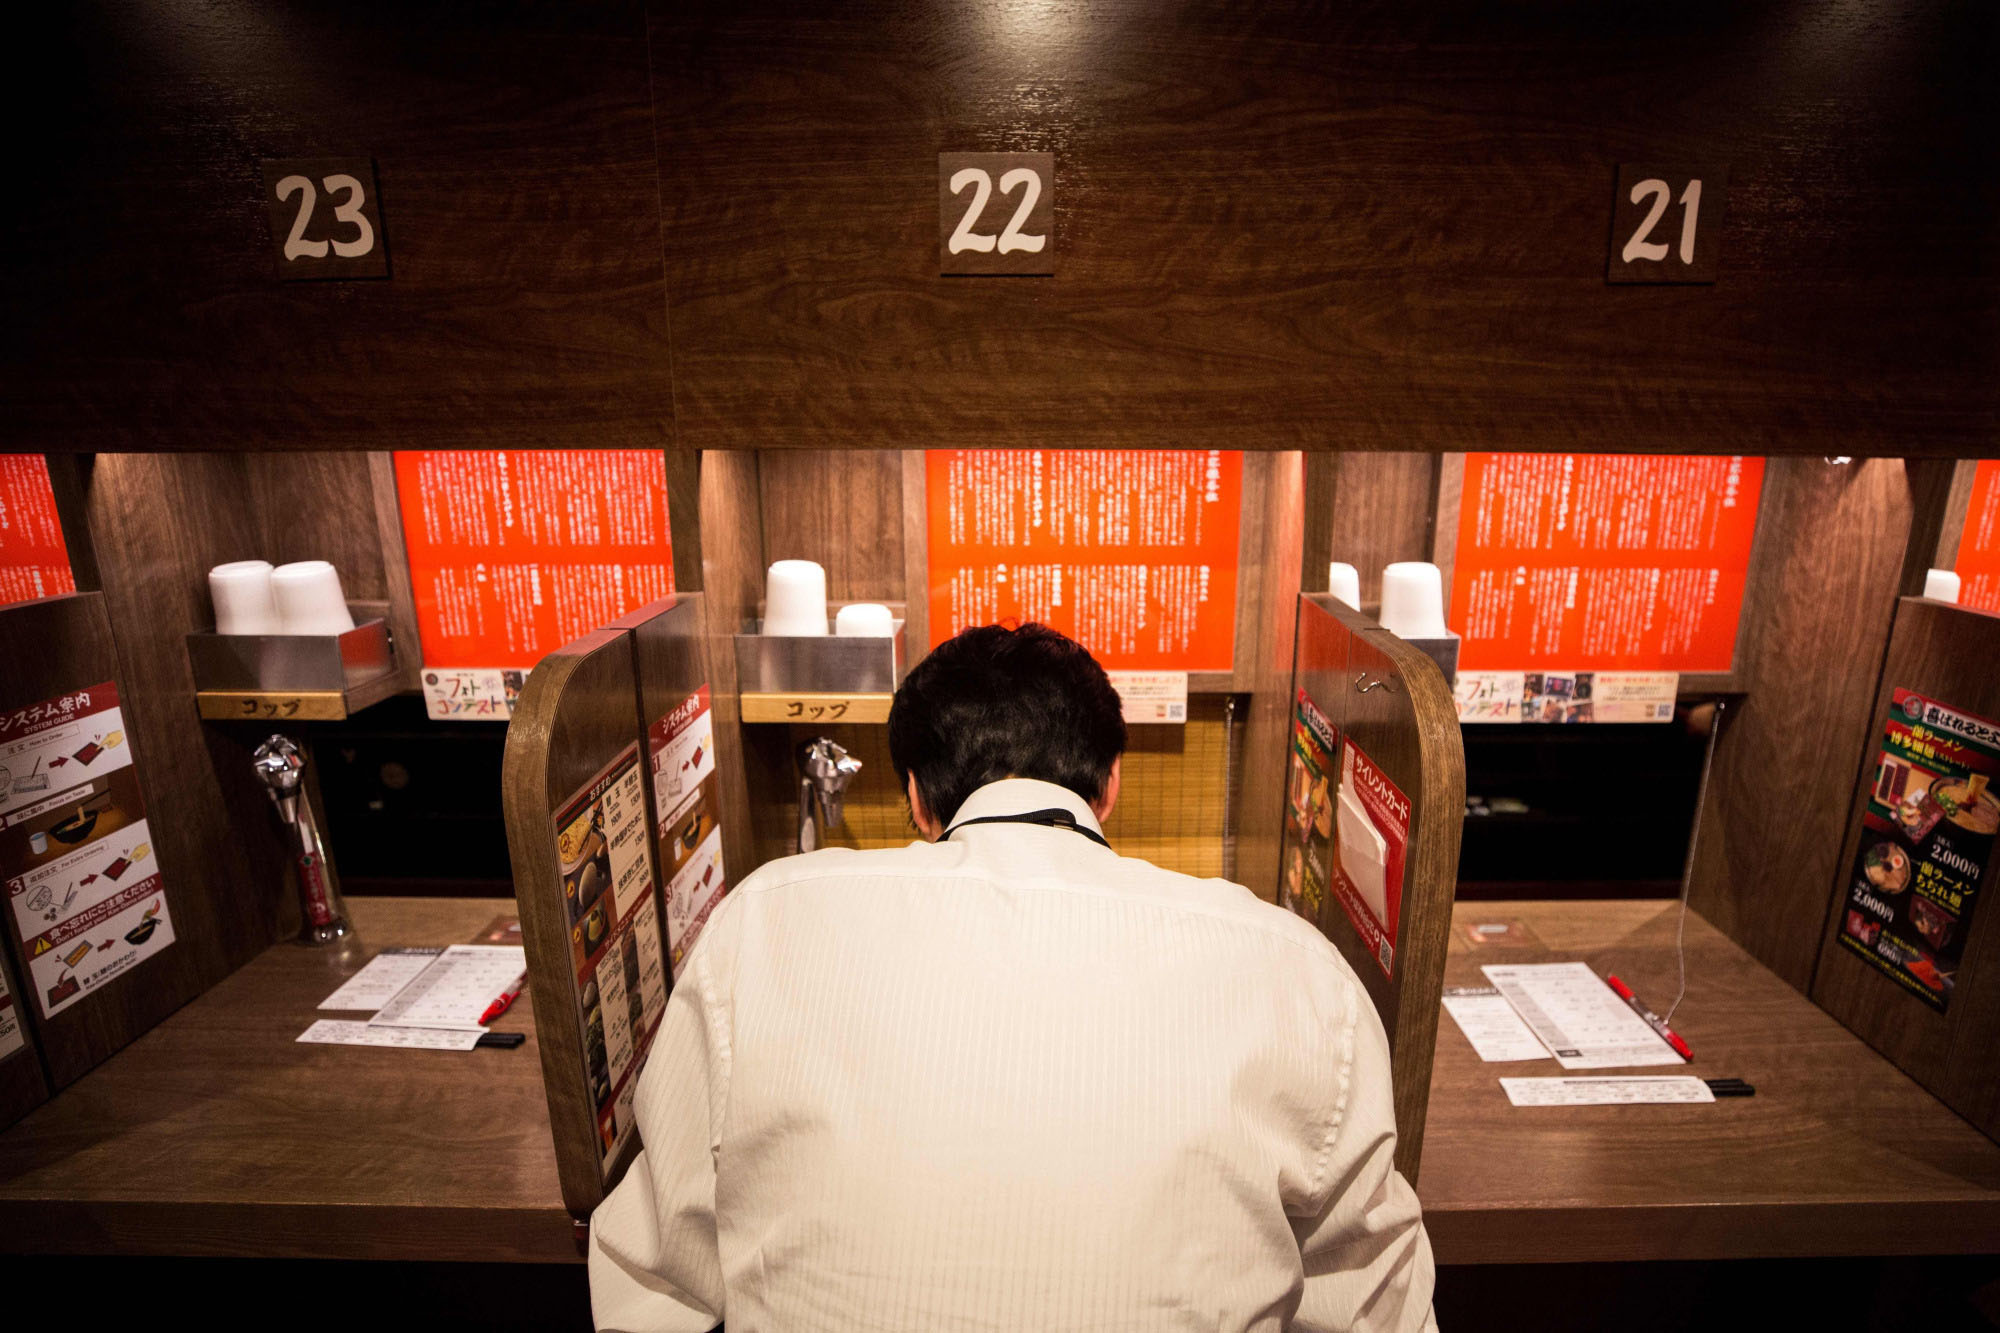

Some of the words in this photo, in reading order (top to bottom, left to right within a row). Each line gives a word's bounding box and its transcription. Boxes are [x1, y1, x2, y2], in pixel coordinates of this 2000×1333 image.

[275, 174, 375, 262] 23
[948, 167, 1047, 256] 22
[1622, 178, 1703, 265] 21
[0, 691, 90, 732] システム案内
[24, 719, 52, 734] SYSTEM
[53, 712, 74, 724] GUIDE
[243, 699, 302, 717] コップ
[786, 697, 837, 714] コップ
[1355, 754, 1408, 820] サイレントカード
[1911, 858, 1975, 896] 一蘭ラーメン
[1930, 843, 1980, 881] 2,000円
[10, 879, 22, 896] 3
[1851, 886, 1895, 924] 2,000円
